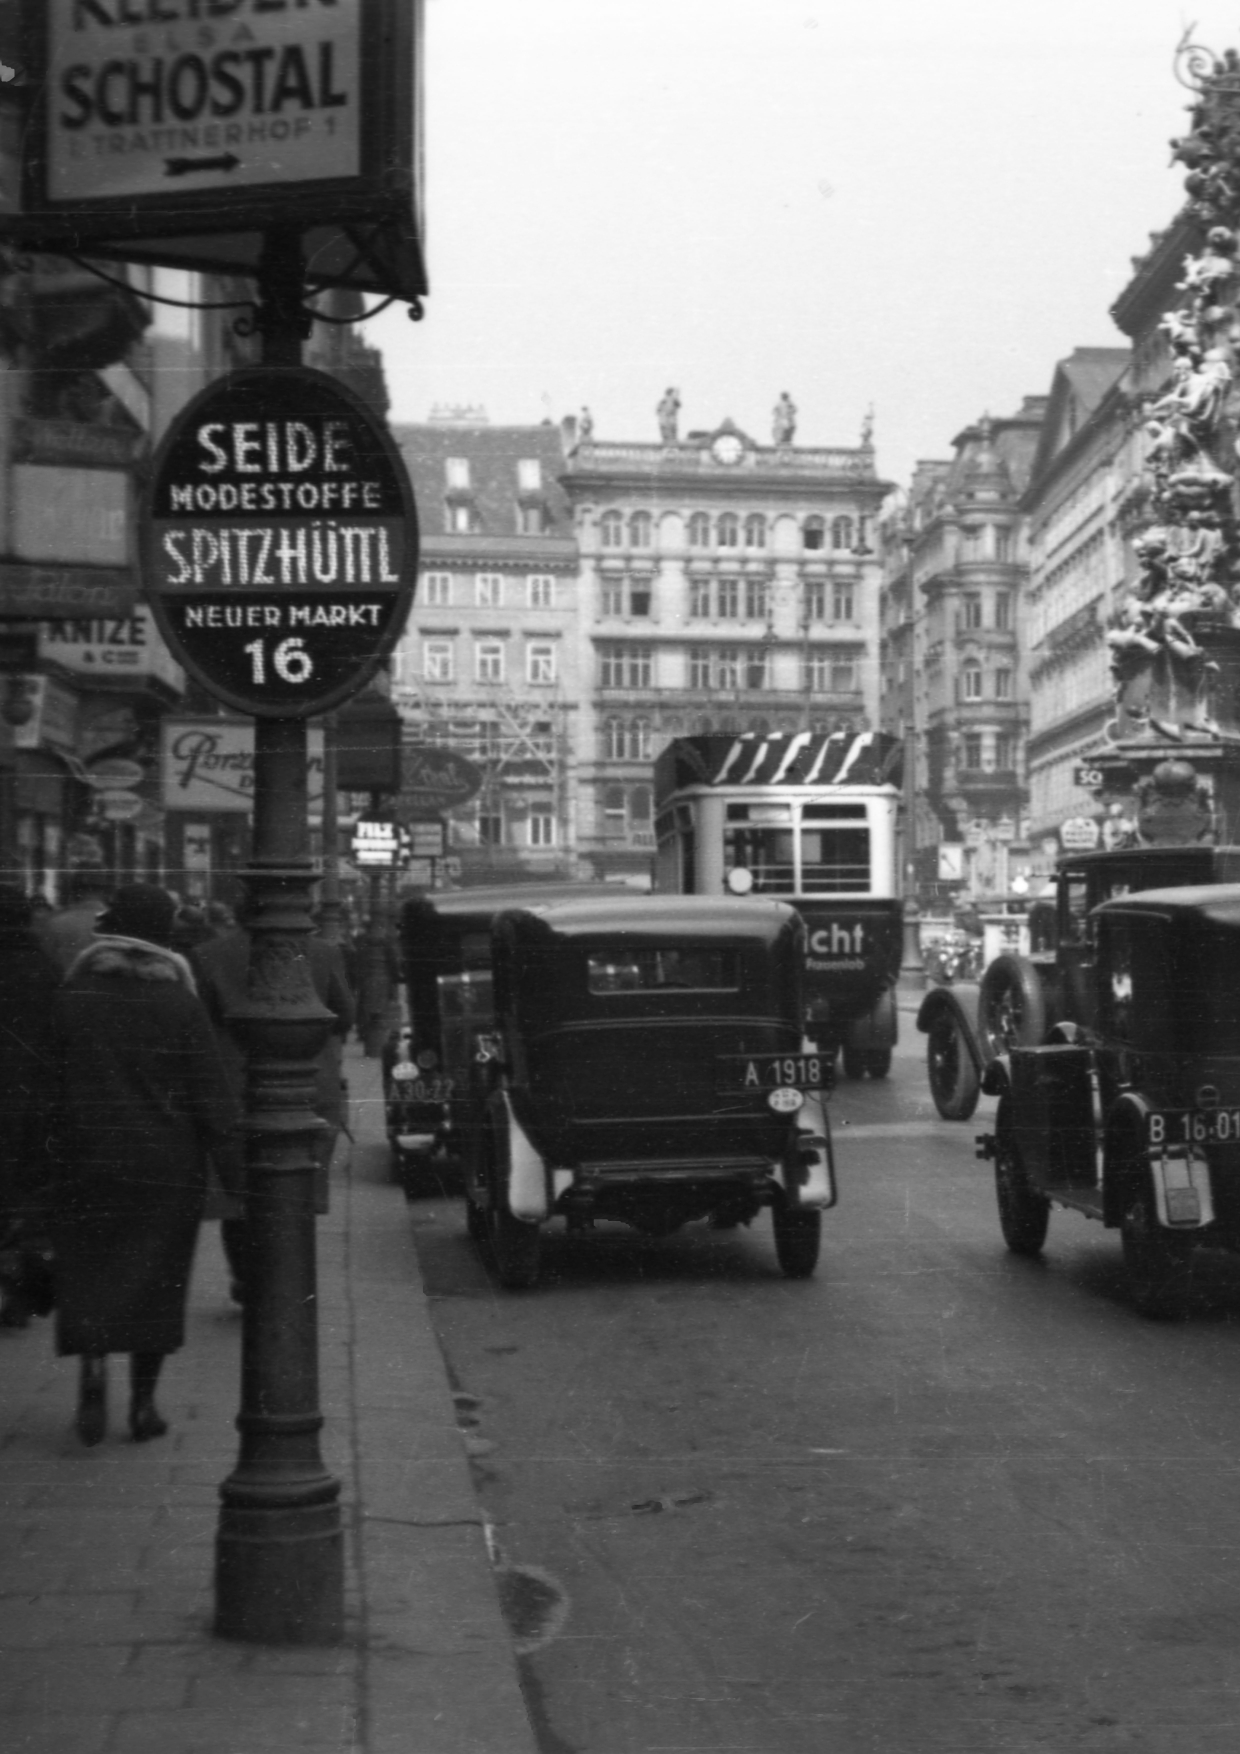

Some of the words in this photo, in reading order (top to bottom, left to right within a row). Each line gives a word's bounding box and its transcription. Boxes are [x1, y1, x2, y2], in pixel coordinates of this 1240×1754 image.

[132, 23, 256, 54] ELSA
[60, 41, 347, 130] SCHOSTAL
[96, 118, 311, 154] TRATTNERHOF
[198, 422, 350, 473] SEIDE
[170, 482, 382, 511] MODESTOFFE
[163, 520, 399, 584] SPITZHÜTTL
[48, 616, 147, 646] KNIZE
[185, 605, 281, 627] NEUER
[290, 604, 382, 627] MARKT
[244, 637, 313, 684] 16
[745, 1061, 759, 1086] A
[772, 1059, 820, 1084] 1918
[1149, 1113, 1165, 1143] B
